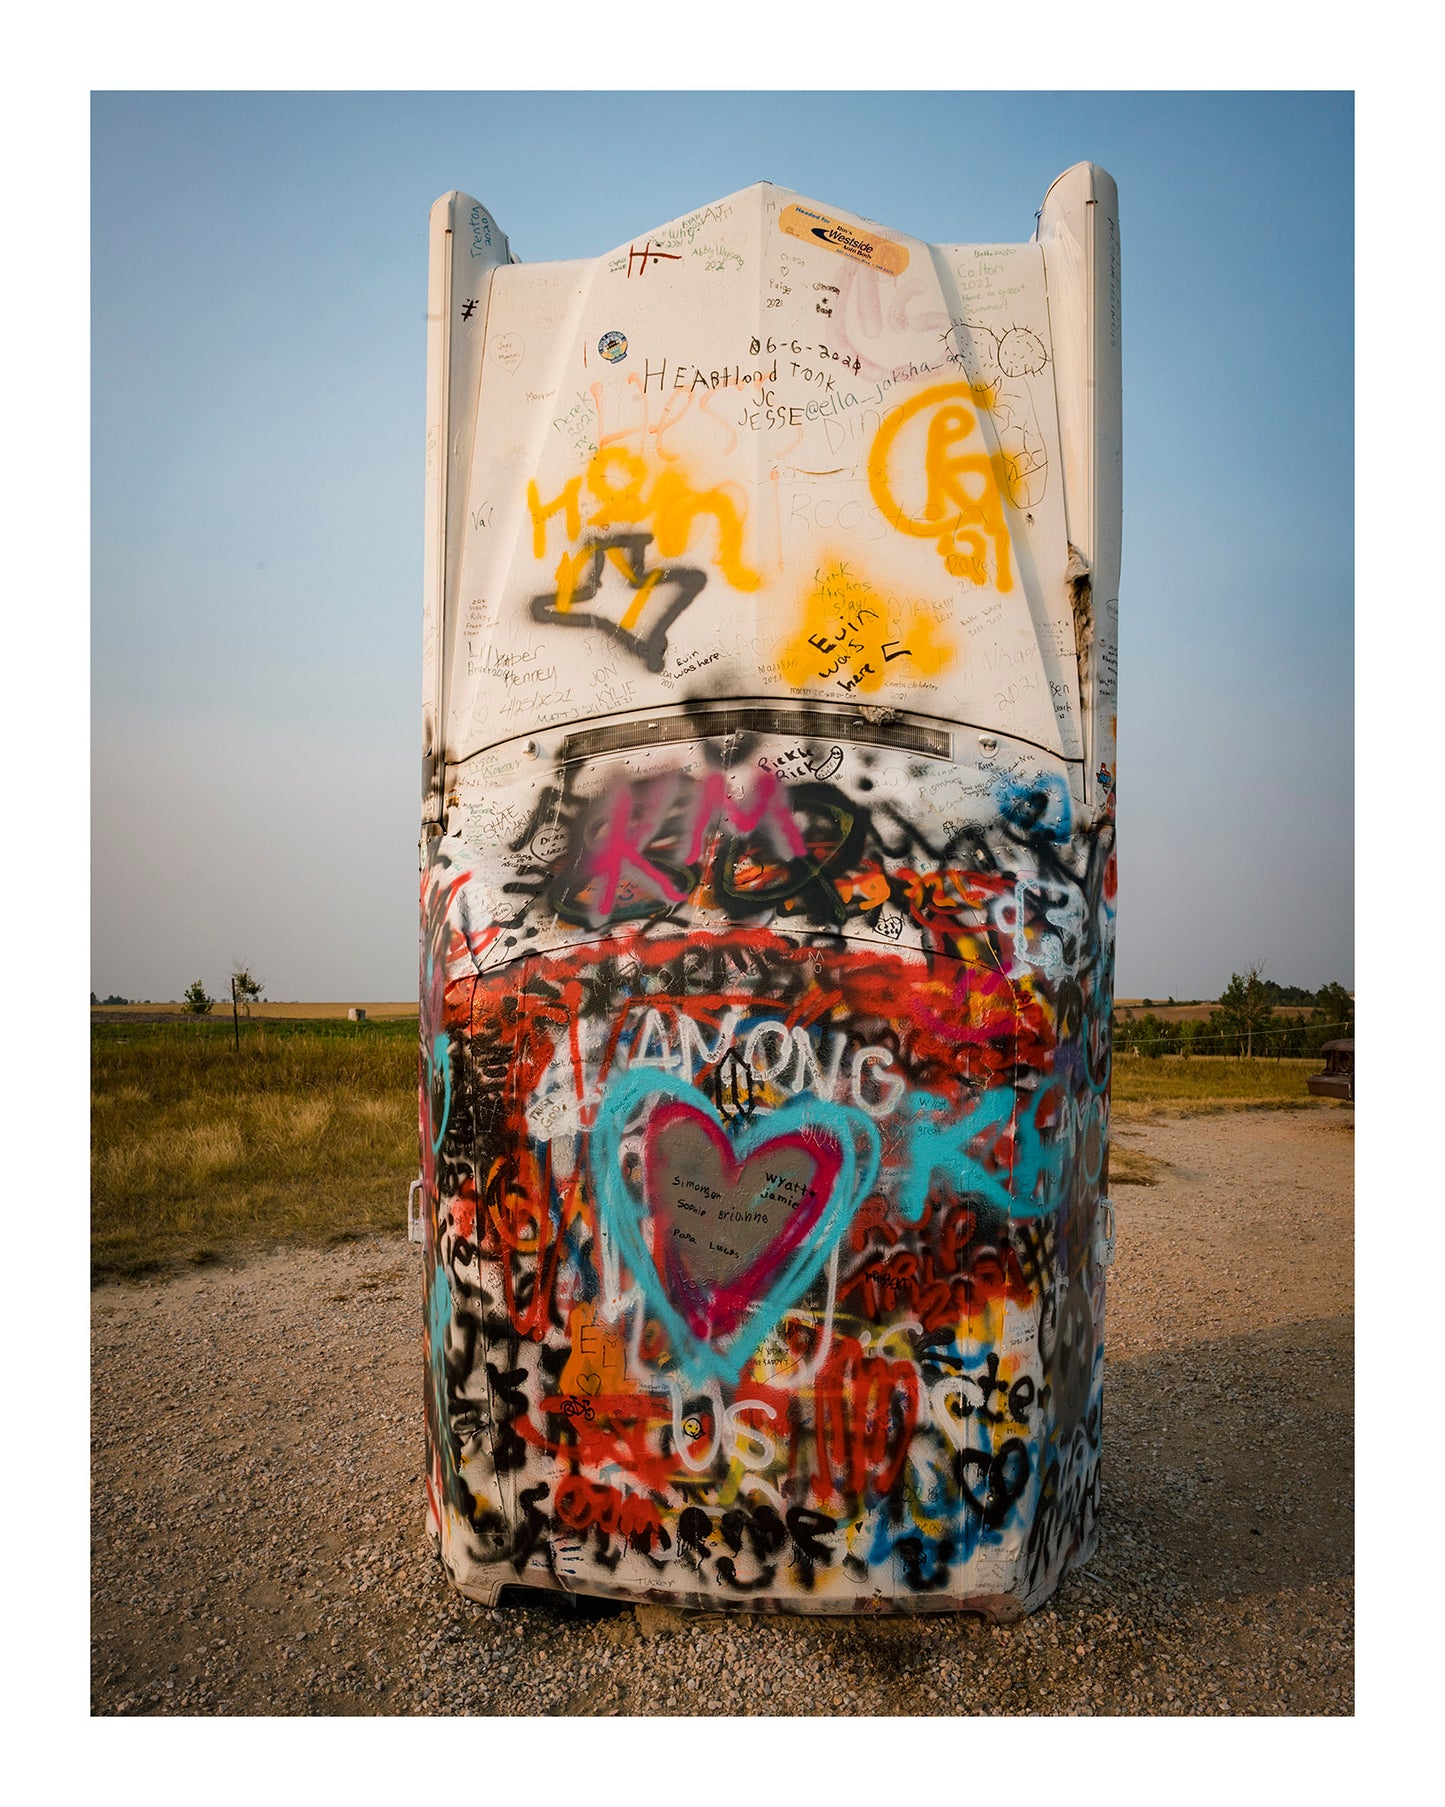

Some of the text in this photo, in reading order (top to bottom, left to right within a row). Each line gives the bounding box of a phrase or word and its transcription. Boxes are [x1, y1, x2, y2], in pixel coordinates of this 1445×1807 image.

[467, 206, 483, 259] Trenton
[827, 228, 875, 255] Westside
[960, 277, 993, 291] 2021
[751, 386, 777, 408] JC
[737, 405, 805, 432] JESSE
[697, 651, 721, 669] here
[589, 663, 618, 687] JON
[836, 663, 877, 692] here
[595, 680, 638, 706] KYLIE
[628, 1008, 906, 1118] AMONG
